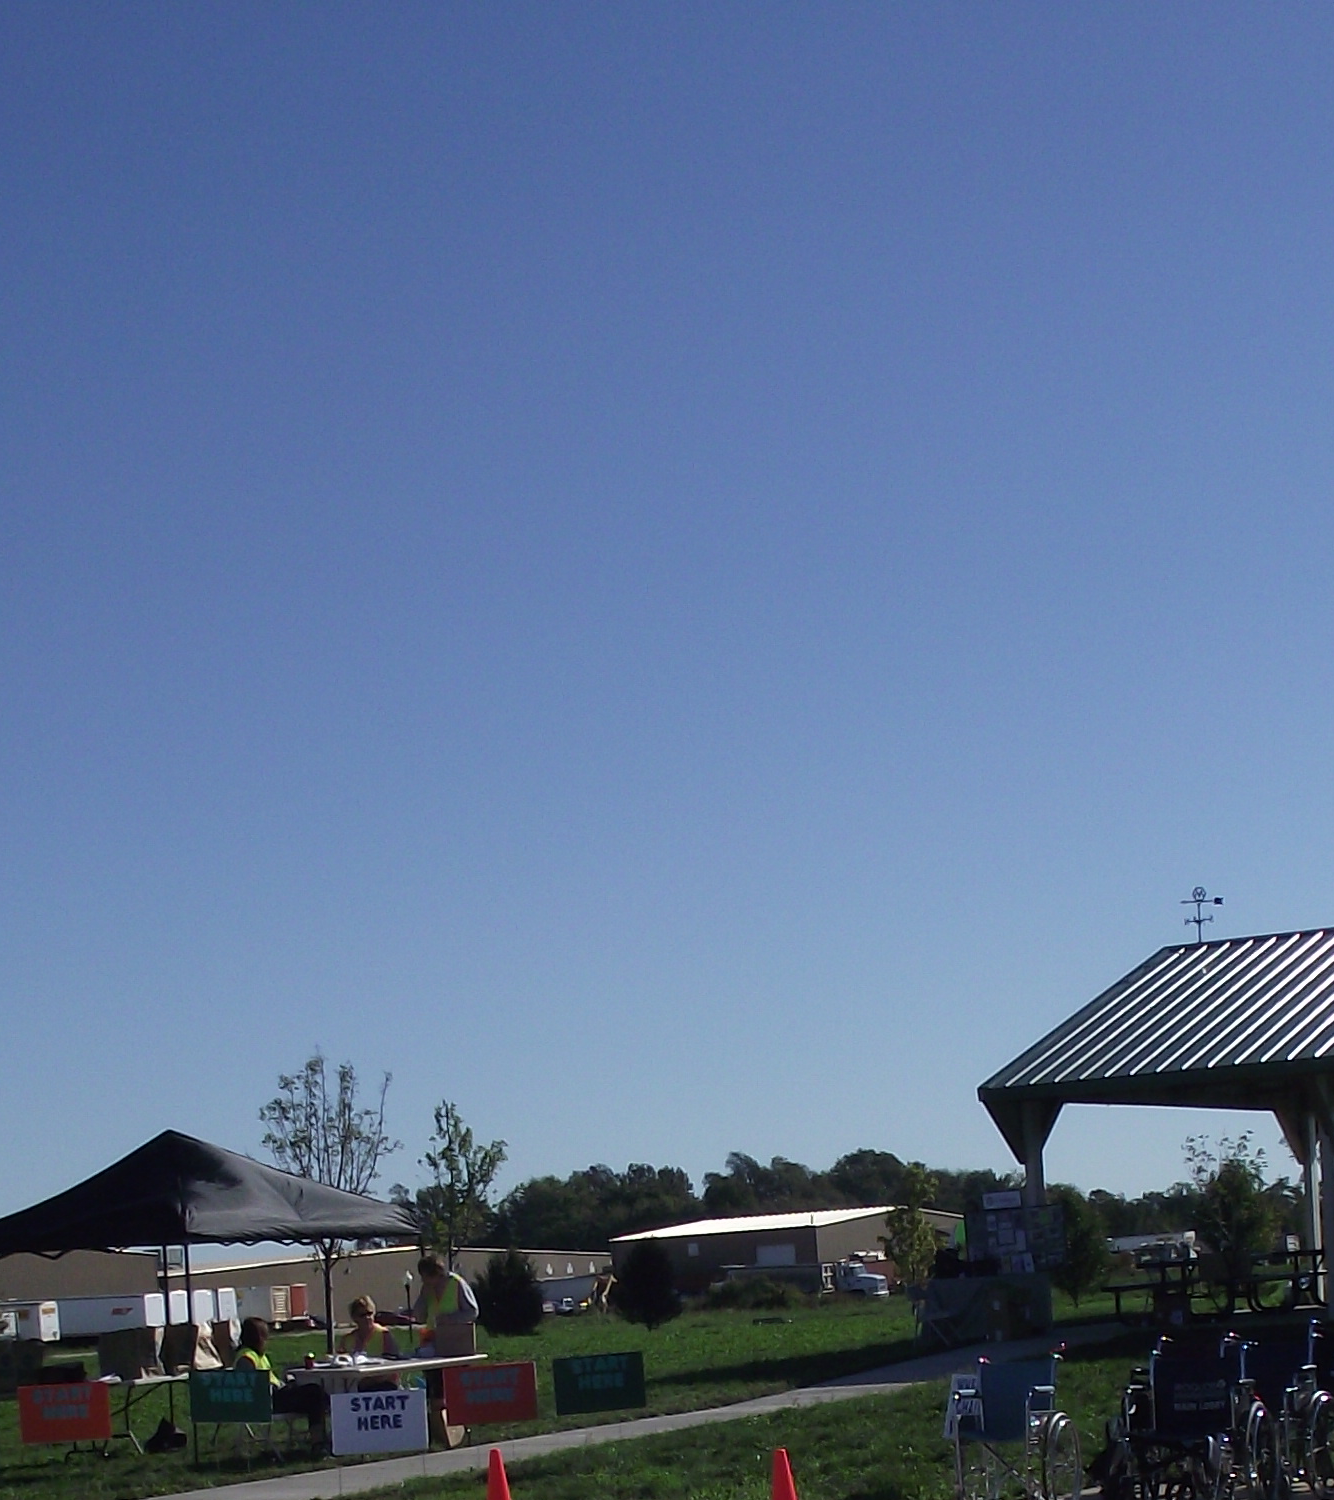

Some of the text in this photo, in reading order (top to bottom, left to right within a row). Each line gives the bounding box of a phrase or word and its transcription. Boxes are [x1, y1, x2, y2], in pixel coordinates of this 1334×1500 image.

[571, 1355, 629, 1374] START
[200, 1372, 257, 1387] START
[460, 1367, 521, 1387] START
[578, 1372, 624, 1390] HERE
[33, 1386, 91, 1404] START
[210, 1388, 253, 1402] HERE
[350, 1394, 409, 1412] START
[42, 1403, 88, 1420] HERE
[357, 1414, 403, 1431] HERE
